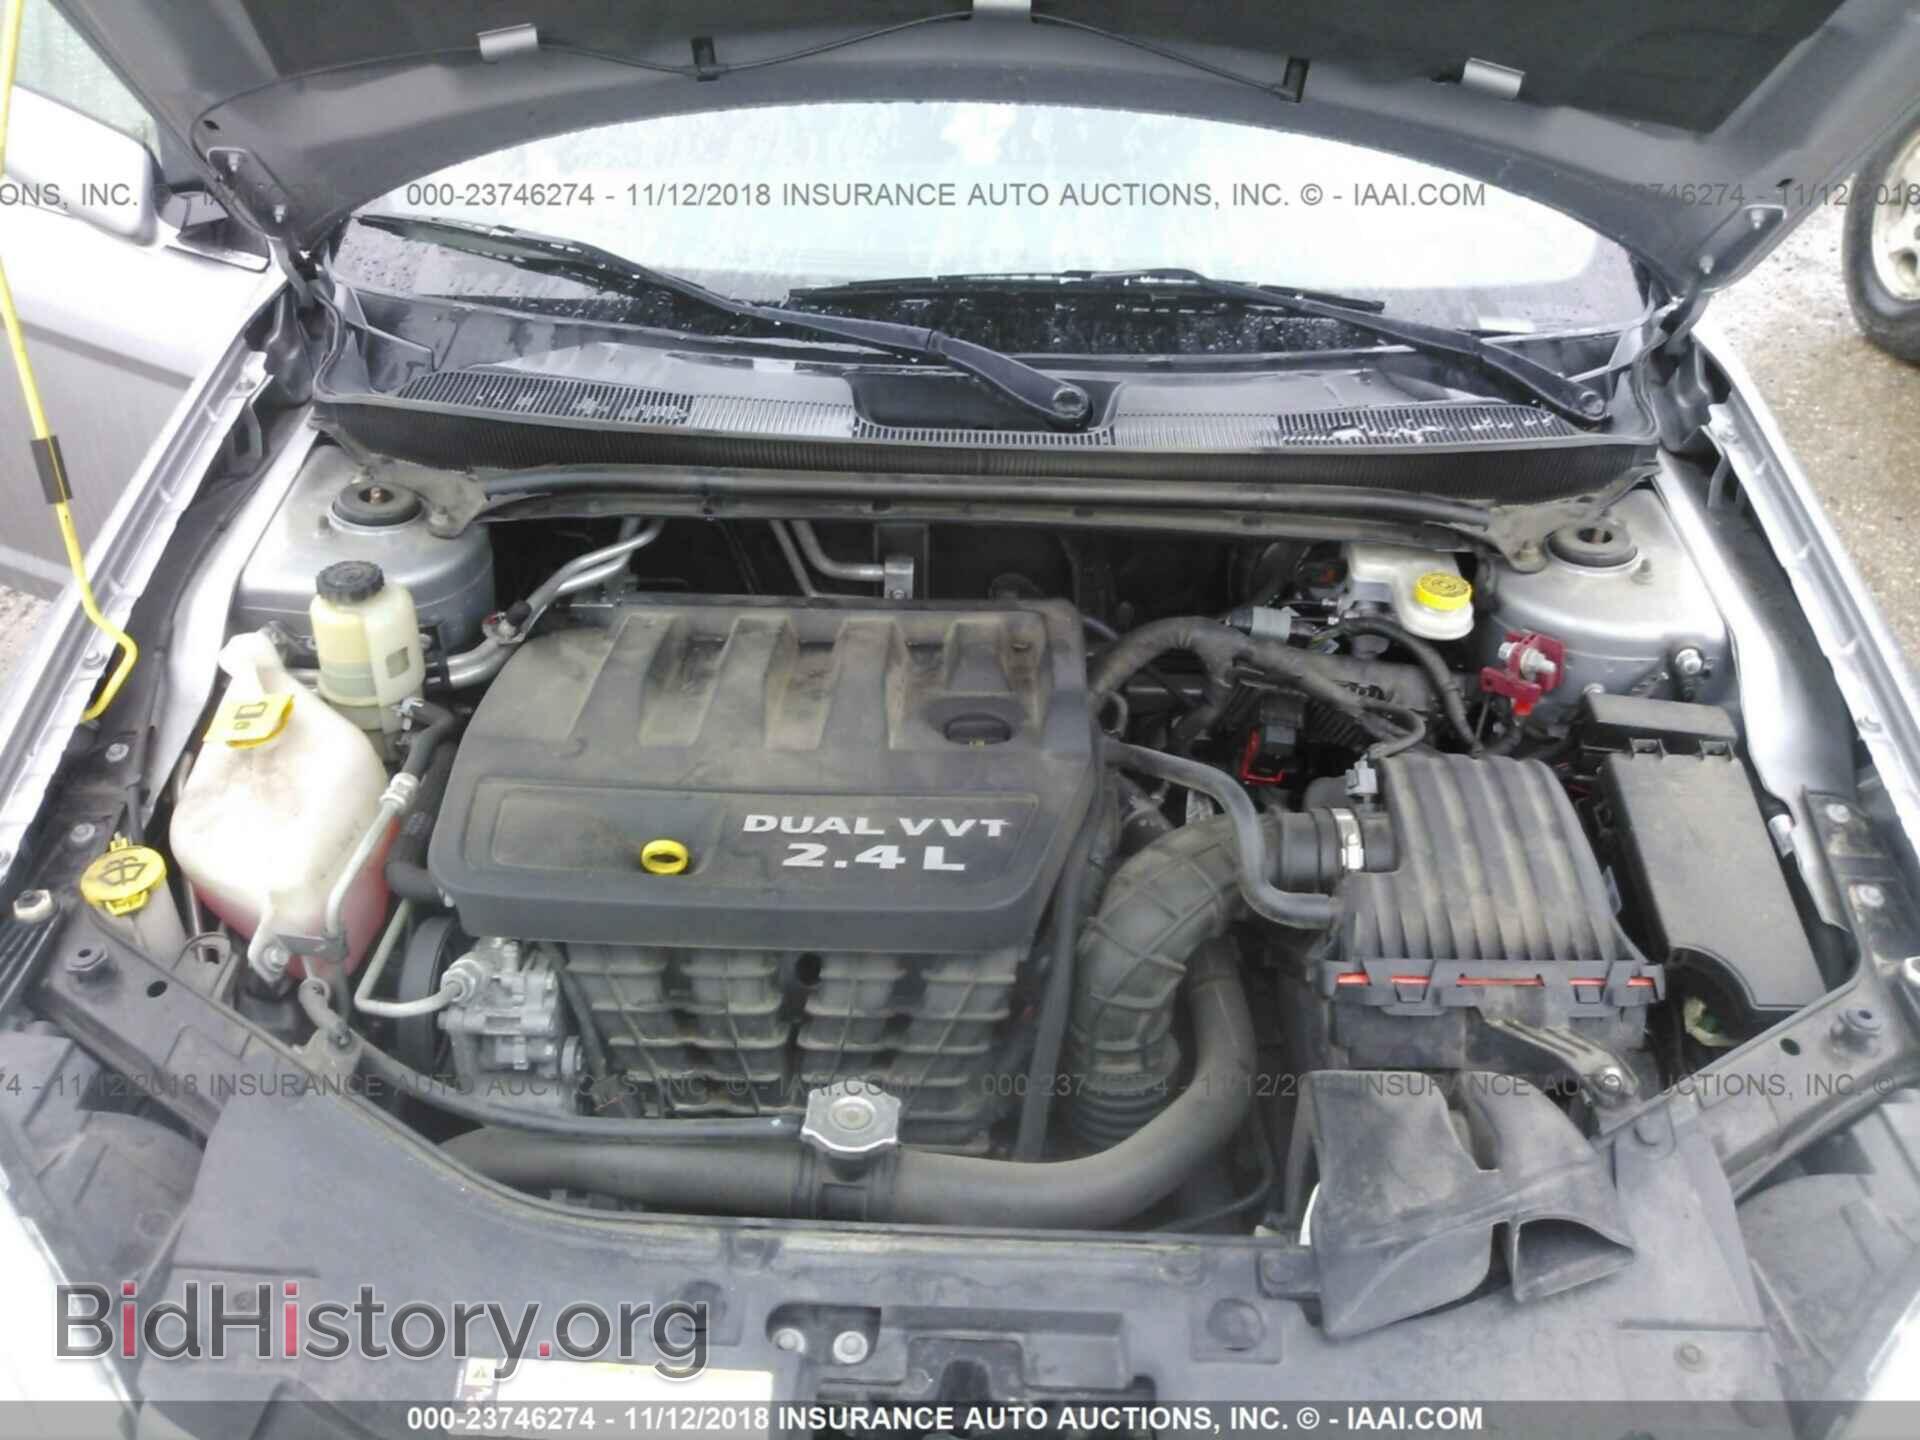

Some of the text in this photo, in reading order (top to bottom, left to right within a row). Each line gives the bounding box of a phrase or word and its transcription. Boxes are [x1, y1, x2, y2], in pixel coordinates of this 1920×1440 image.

[742, 814, 1012, 837] DUAL VVT
[781, 843, 966, 871] 2.4 L
